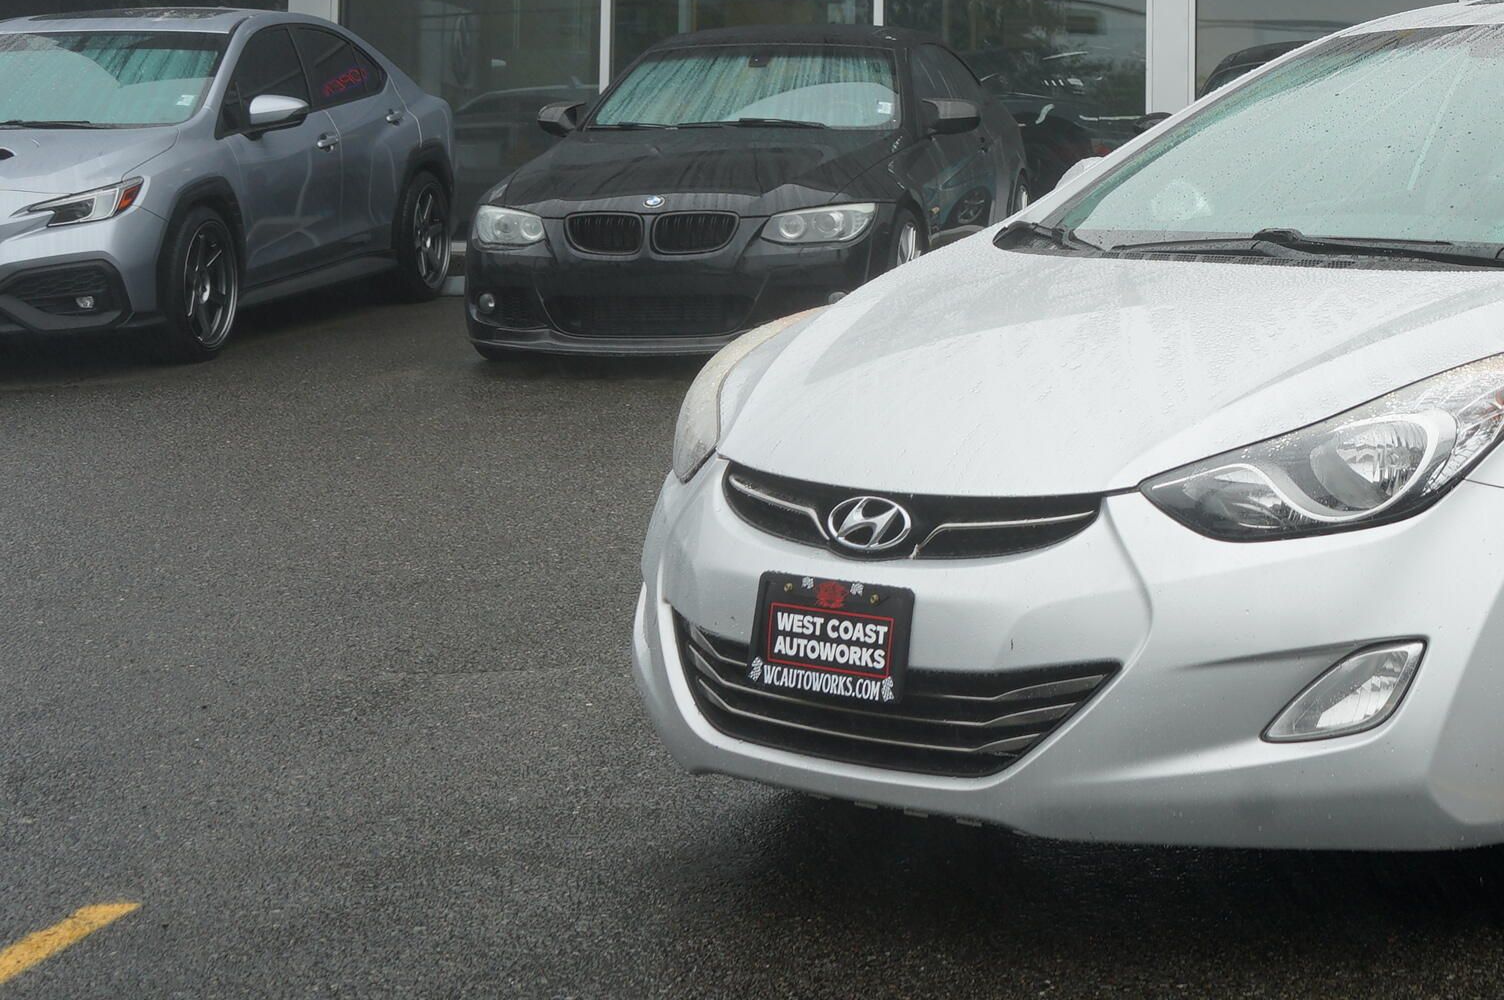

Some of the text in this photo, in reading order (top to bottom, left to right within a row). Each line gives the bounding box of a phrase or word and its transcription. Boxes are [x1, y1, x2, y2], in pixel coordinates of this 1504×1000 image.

[776, 611, 888, 644] WEST COAST
[773, 635, 886, 669] AUTOWORKS
[763, 665, 881, 700] WCAUTOWORKS.COM
